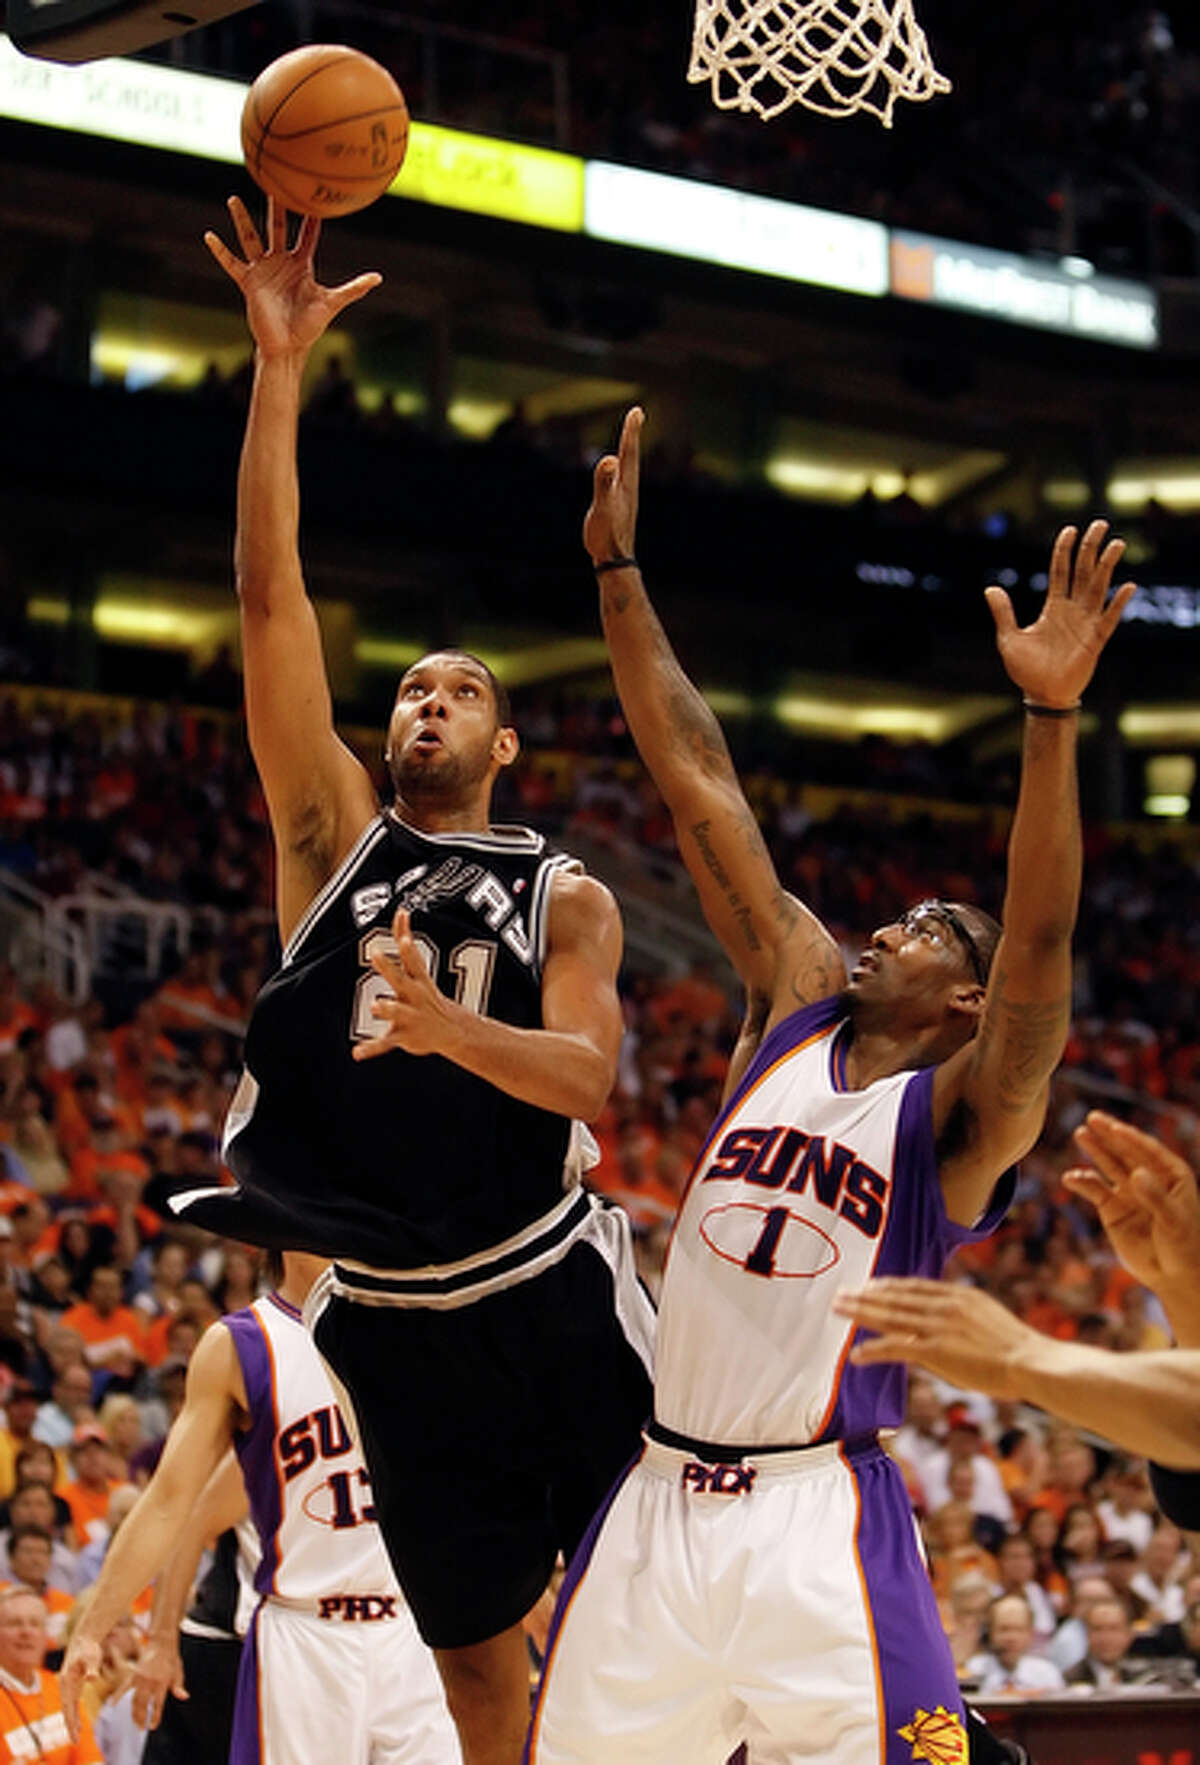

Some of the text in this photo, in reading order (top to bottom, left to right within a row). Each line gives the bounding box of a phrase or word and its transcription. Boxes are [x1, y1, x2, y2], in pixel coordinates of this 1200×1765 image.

[349, 926, 498, 1041] 21
[702, 1125, 890, 1240] SUNS
[743, 1205, 791, 1278] 1
[682, 1462, 758, 1496] PHX
[318, 1594, 397, 1622] PHX
